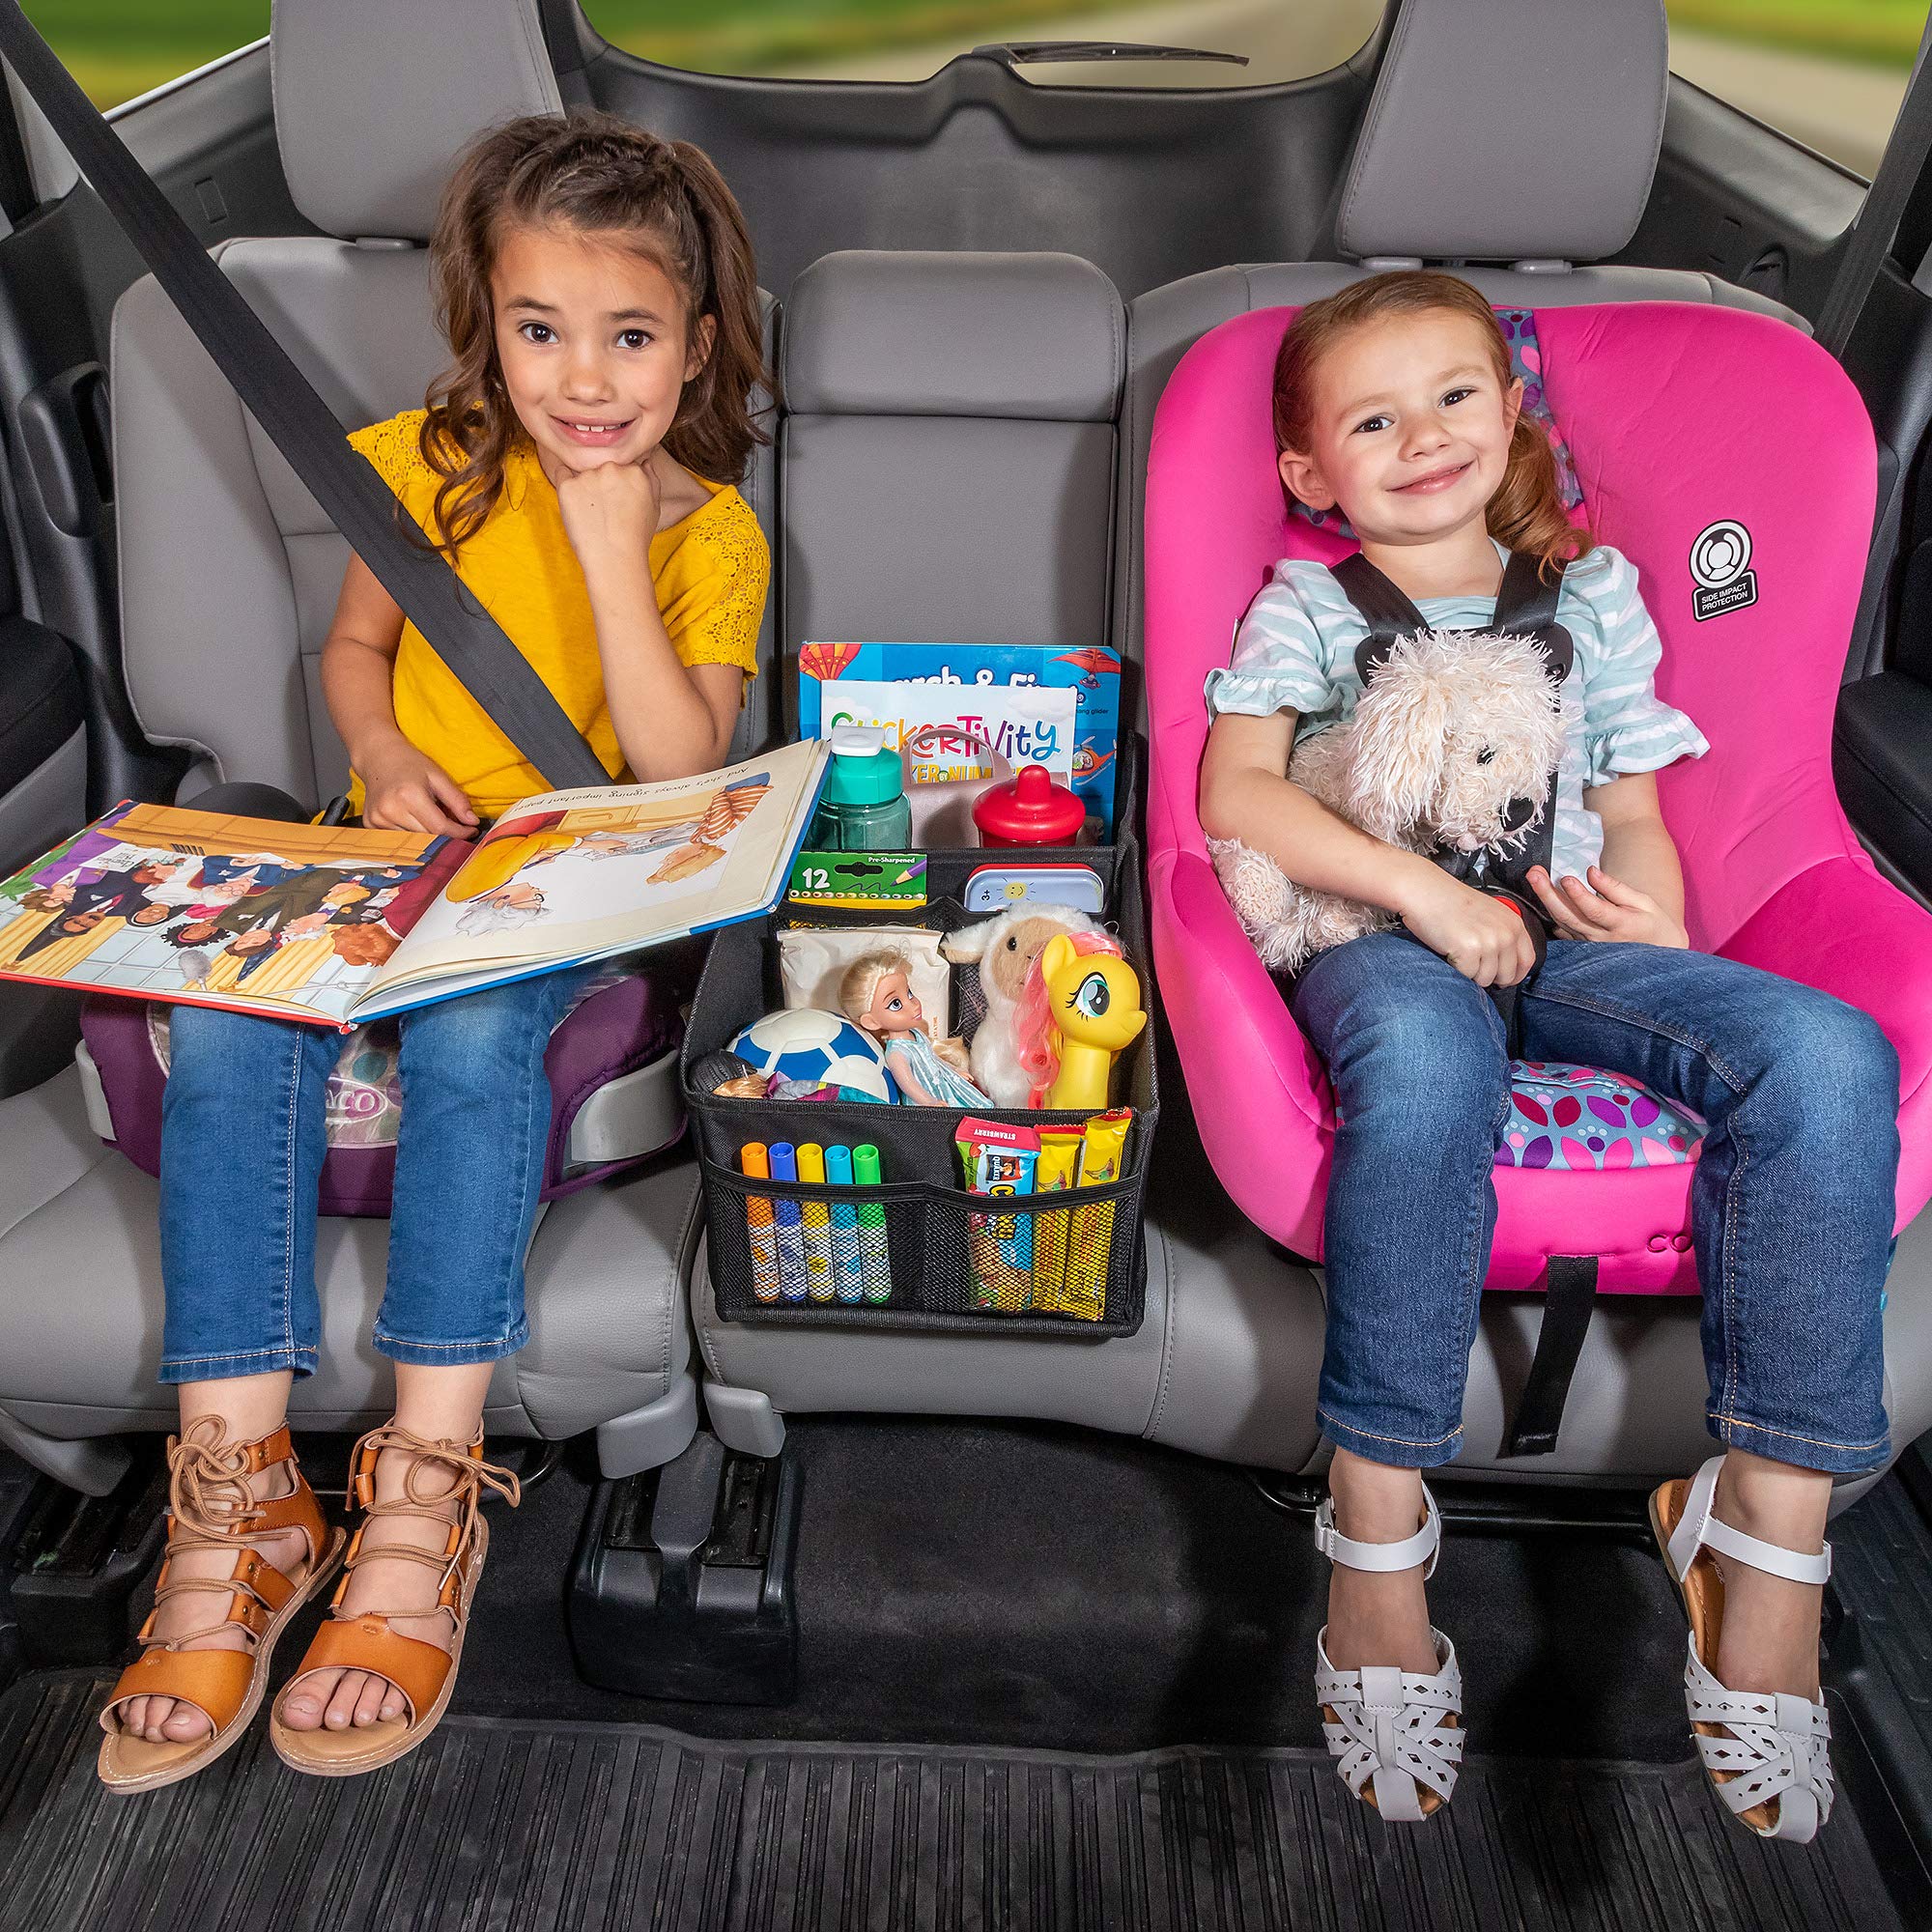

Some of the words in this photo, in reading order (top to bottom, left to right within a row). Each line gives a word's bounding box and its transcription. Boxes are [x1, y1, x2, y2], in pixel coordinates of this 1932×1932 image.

[1701, 592, 1719, 604] SIDE
[1719, 582, 1747, 597] IMPACT
[1702, 590, 1748, 611] PROTECTION
[608, 788, 650, 798] signing
[655, 783, 691, 794] always
[547, 793, 603, 805] important
[867, 856, 916, 865] Pre-Sharpened
[802, 867, 831, 890] 12
[980, 889, 991, 901] 3+
[974, 1128, 1016, 1141] STRAWBERRY
[992, 1155, 1002, 1181] QUAKER
